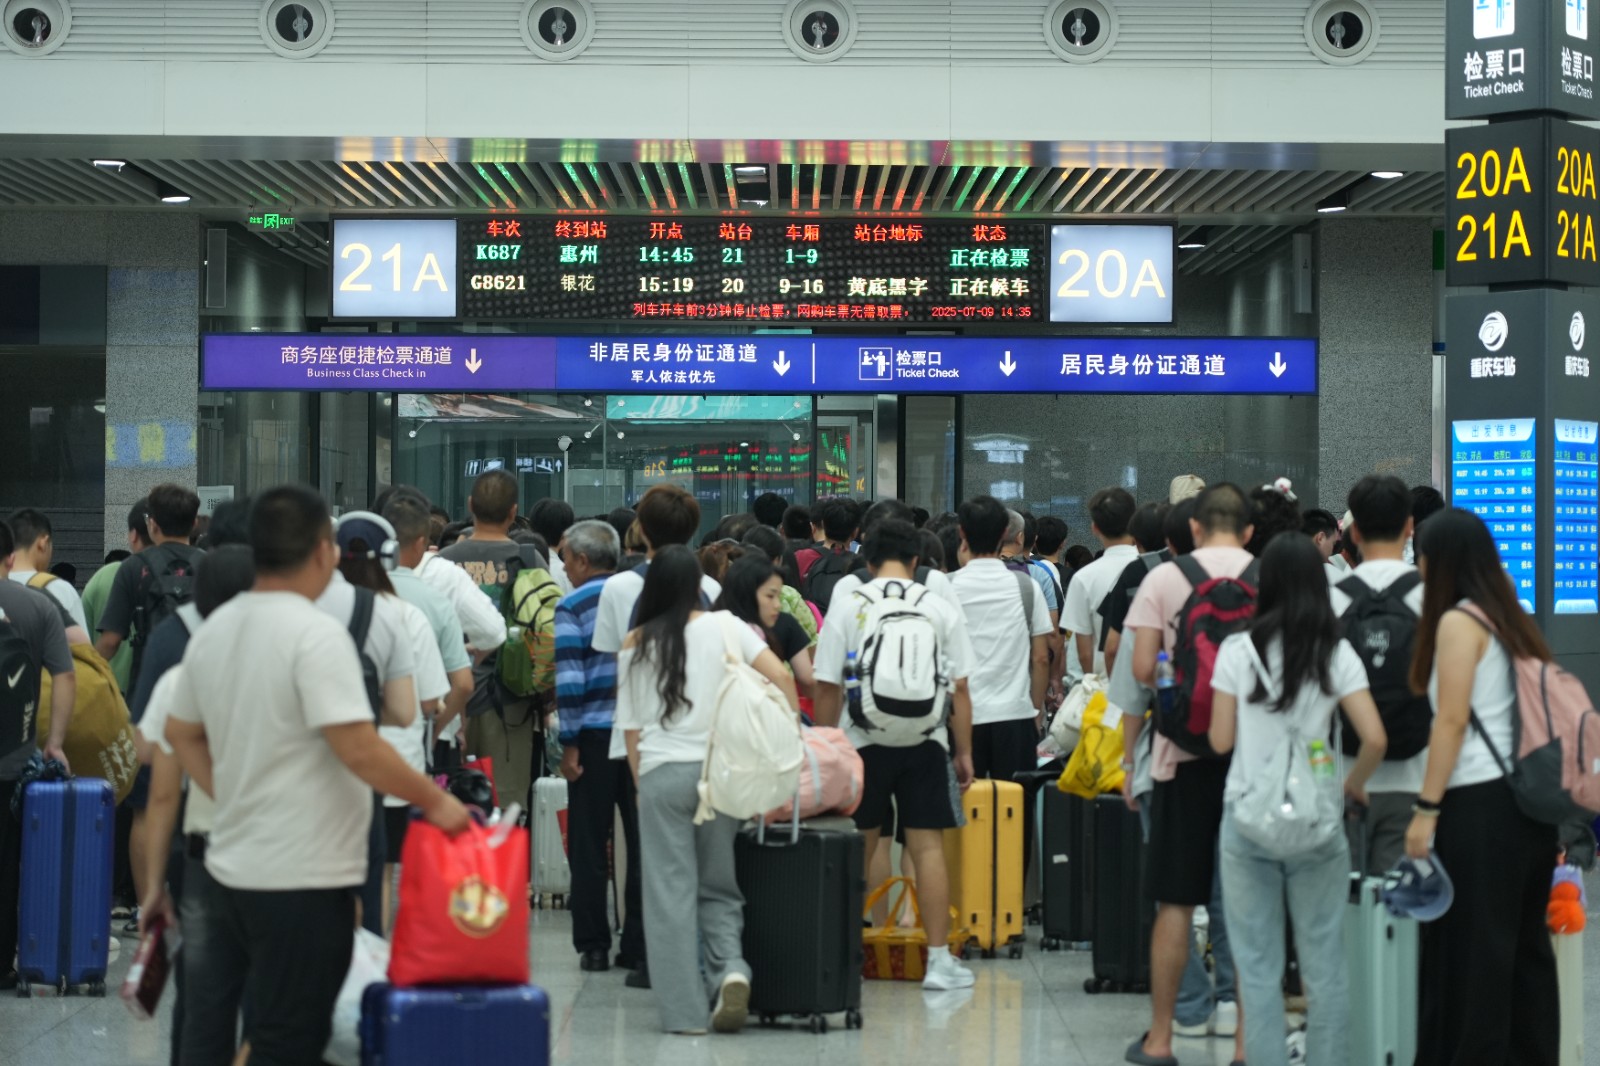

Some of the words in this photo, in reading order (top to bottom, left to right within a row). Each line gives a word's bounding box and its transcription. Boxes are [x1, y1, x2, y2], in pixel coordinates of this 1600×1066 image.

[1463, 47, 1525, 82] 检票口
[1561, 45, 1593, 82] 检票口
[1463, 84, 1492, 98] Ticket
[1493, 79, 1524, 95] Check
[1561, 79, 1577, 95] Ticket
[1577, 83, 1593, 99] Check
[1456, 146, 1532, 200] 20A
[1557, 146, 1597, 200] 20A
[279, 217, 295, 225] EXIT
[487, 219, 522, 238] 车次
[555, 220, 607, 239] 终到站
[649, 221, 683, 240] 开点
[718, 222, 753, 241] 站台
[785, 223, 820, 241] 车厢
[854, 223, 923, 242] 站台地标
[971, 224, 1007, 242] 状态
[1456, 209, 1532, 262] 21A
[1557, 209, 1597, 262] 21A
[339, 242, 449, 292] 21A
[476, 244, 522, 260] K687
[559, 244, 598, 264] 惠州
[639, 246, 694, 263] 14:45
[722, 247, 744, 264] 21
[785, 248, 819, 264] 1-9
[949, 247, 1030, 268] 正在检票
[470, 274, 526, 290] G8621
[560, 273, 595, 292] 银花
[639, 276, 694, 293] 15:19
[721, 277, 745, 294] 20
[779, 278, 824, 295] 9-16
[847, 276, 929, 297] 黄底黑字
[949, 277, 1030, 297] 正在候车
[1057, 248, 1166, 299] 20A
[931, 306, 995, 317] 2025-07-09
[1001, 306, 1032, 317] 14:35
[280, 345, 453, 365] 商务座便捷检票通道
[589, 341, 758, 363] 非居民身份证通道
[895, 349, 942, 366] 检票口
[307, 367, 351, 378] Business
[353, 367, 380, 378] Class
[382, 367, 414, 378] Check
[416, 367, 427, 378] in
[895, 367, 926, 378] Ticket
[927, 367, 960, 378] Check
[1059, 353, 1226, 376] 居民身份证通道
[1470, 356, 1516, 378] 重庆车站
[630, 369, 716, 385] 军人依法优先
